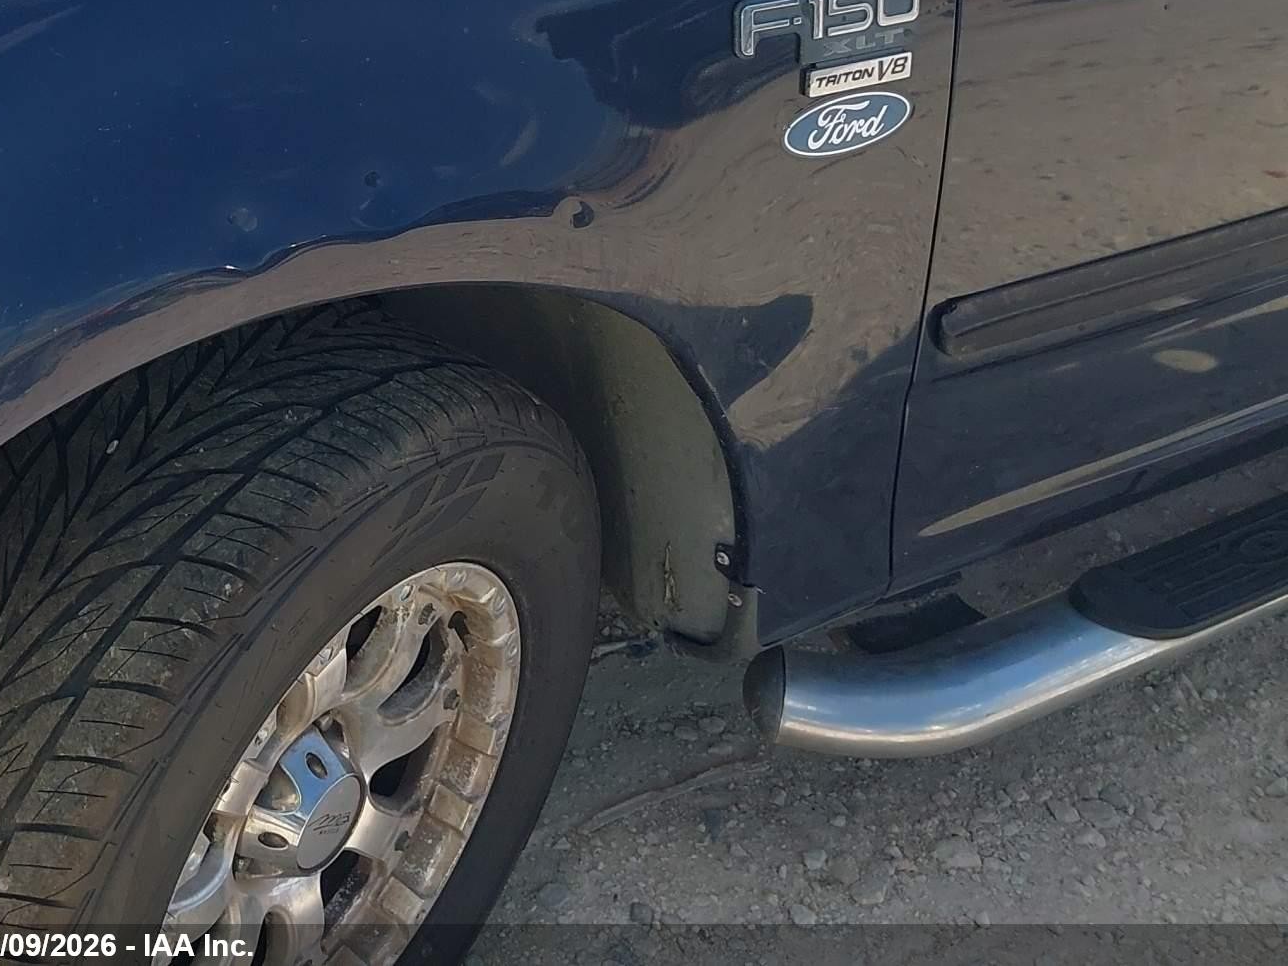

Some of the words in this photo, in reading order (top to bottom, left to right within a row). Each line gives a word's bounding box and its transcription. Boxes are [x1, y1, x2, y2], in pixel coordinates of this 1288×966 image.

[825, 29, 904, 55] XLT
[815, 67, 876, 89] TRITON
[876, 56, 909, 82] V8
[808, 99, 889, 151] Ford
